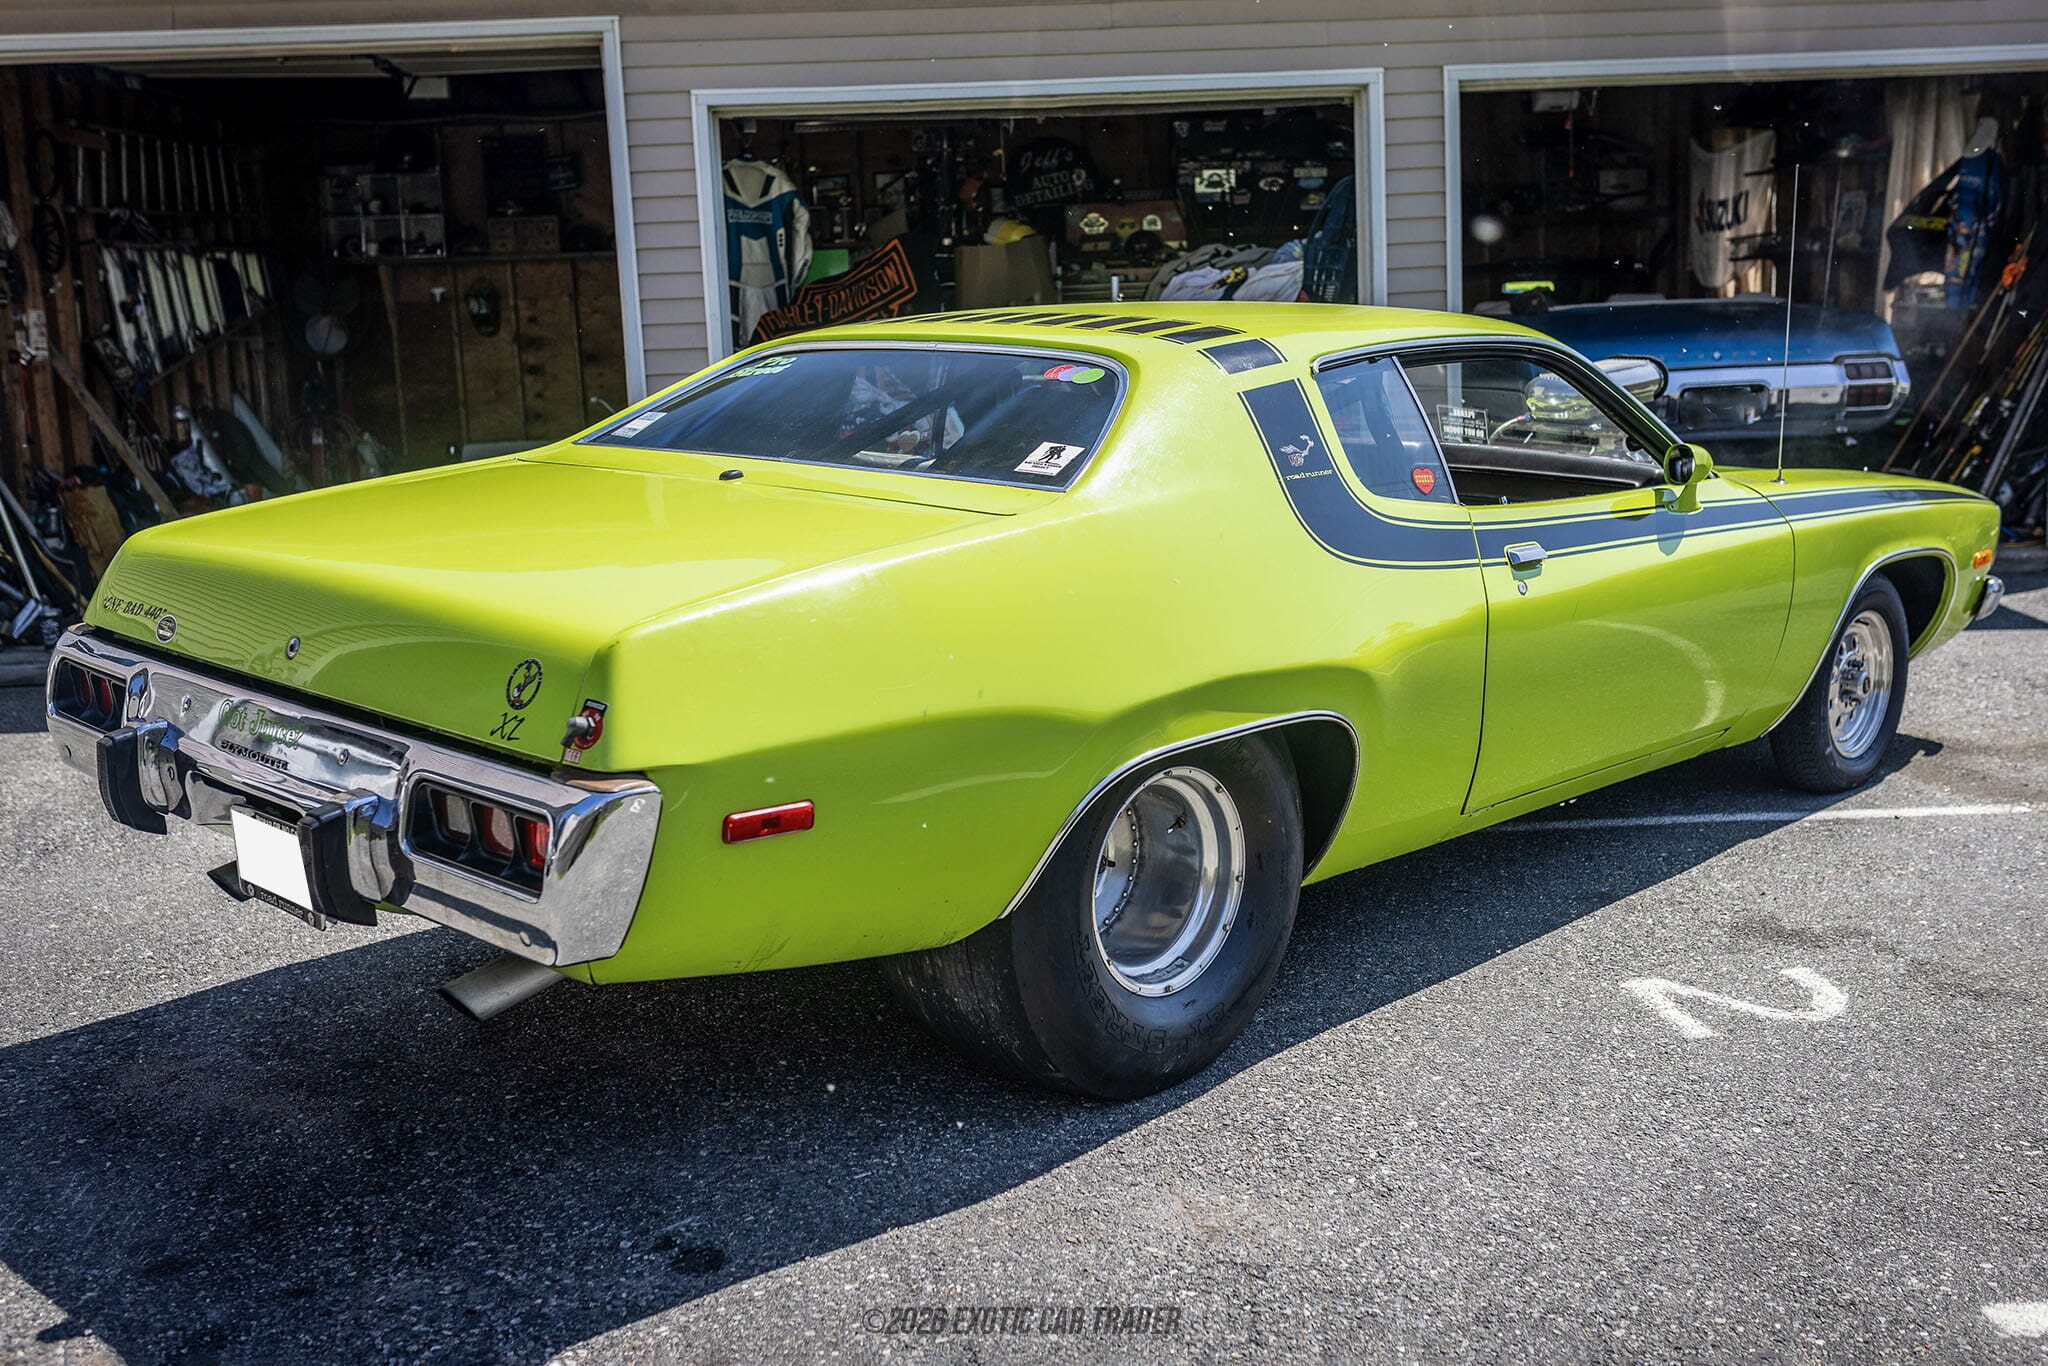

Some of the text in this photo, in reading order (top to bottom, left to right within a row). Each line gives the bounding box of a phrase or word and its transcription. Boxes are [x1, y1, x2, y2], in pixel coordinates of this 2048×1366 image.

[1013, 178, 1094, 207] DETAILIG
[1032, 170, 1070, 191] AUTO
[767, 260, 901, 332] HARLEY-DAVIDSON
[1286, 469, 1333, 481] road runner
[123, 601, 145, 617] BAD
[218, 698, 248, 731] Got
[1620, 966, 1850, 1039] 2
